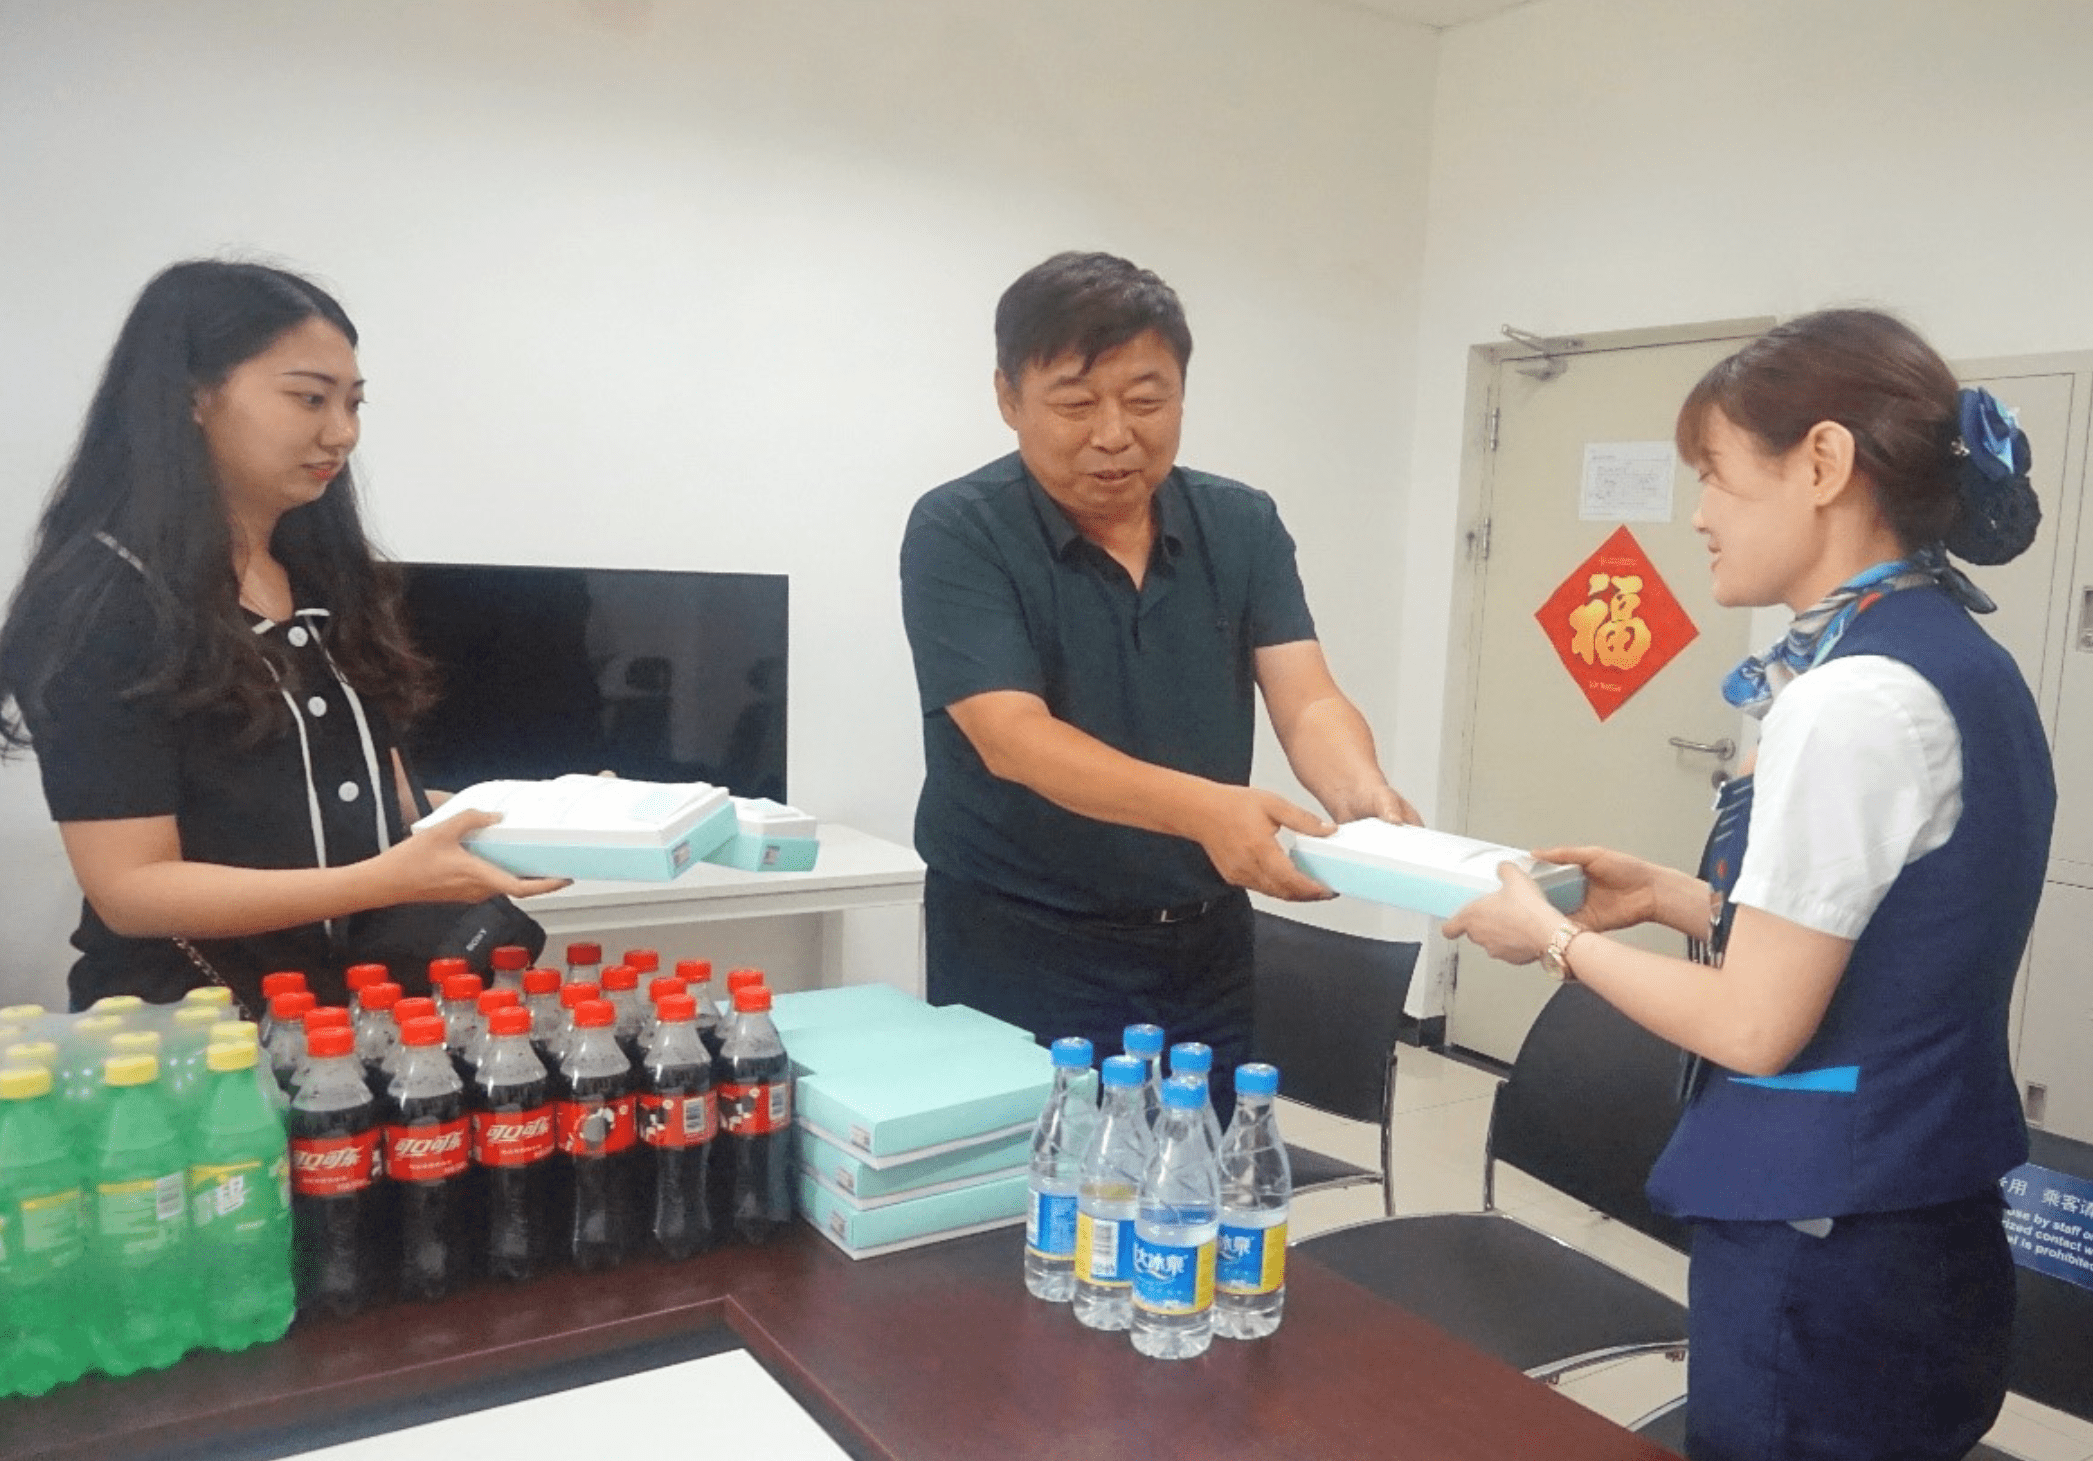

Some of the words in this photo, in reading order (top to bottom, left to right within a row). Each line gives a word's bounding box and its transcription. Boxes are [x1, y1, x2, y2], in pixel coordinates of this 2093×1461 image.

[1568, 573, 1651, 671] 福
[484, 1115, 551, 1144] 可口可乐
[394, 1130, 463, 1158] 可口可乐
[2034, 1213, 2051, 1229] by
[2052, 1221, 2082, 1236] staff
[2021, 1238, 2032, 1250] is
[2035, 1231, 2081, 1252] contact
